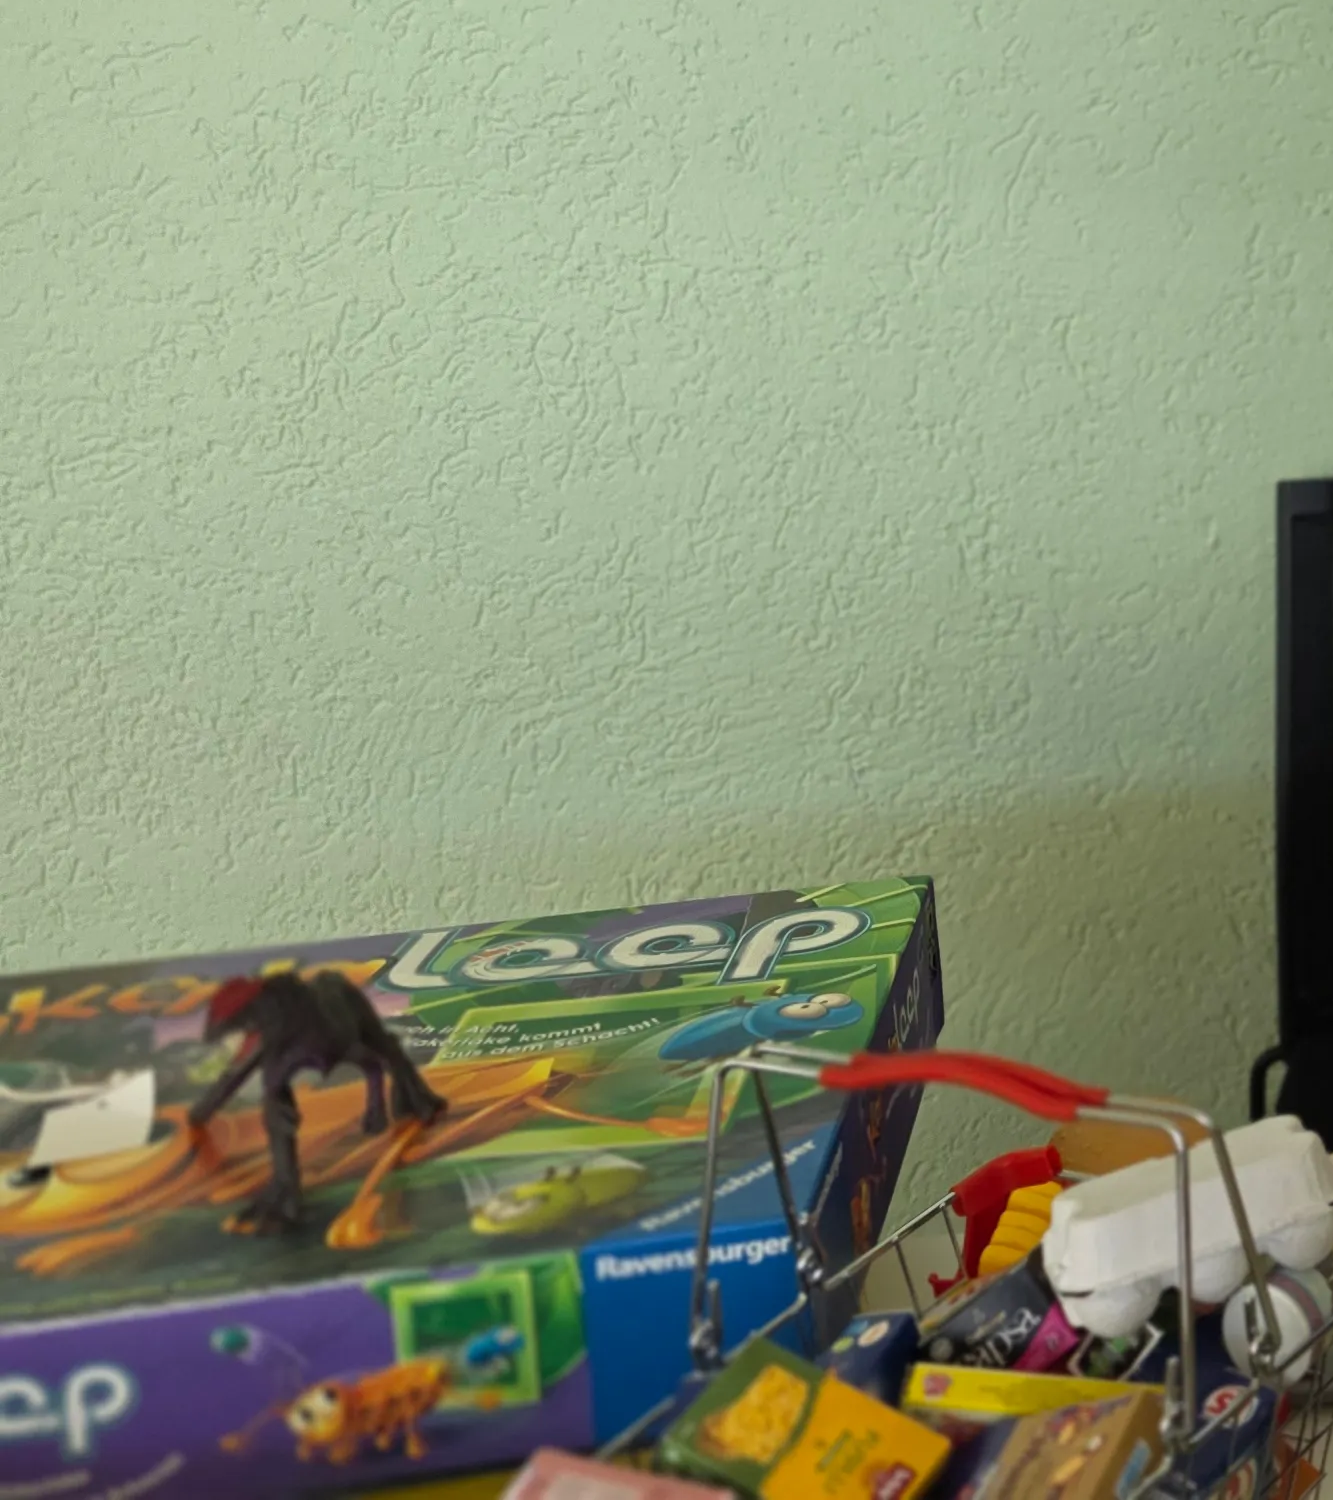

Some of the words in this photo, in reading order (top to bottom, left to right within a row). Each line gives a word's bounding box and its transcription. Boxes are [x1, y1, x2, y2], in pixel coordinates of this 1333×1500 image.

[490, 1044, 544, 1056] dem
[553, 1017, 661, 1049] Schacht!
[519, 1022, 602, 1044] kommt
